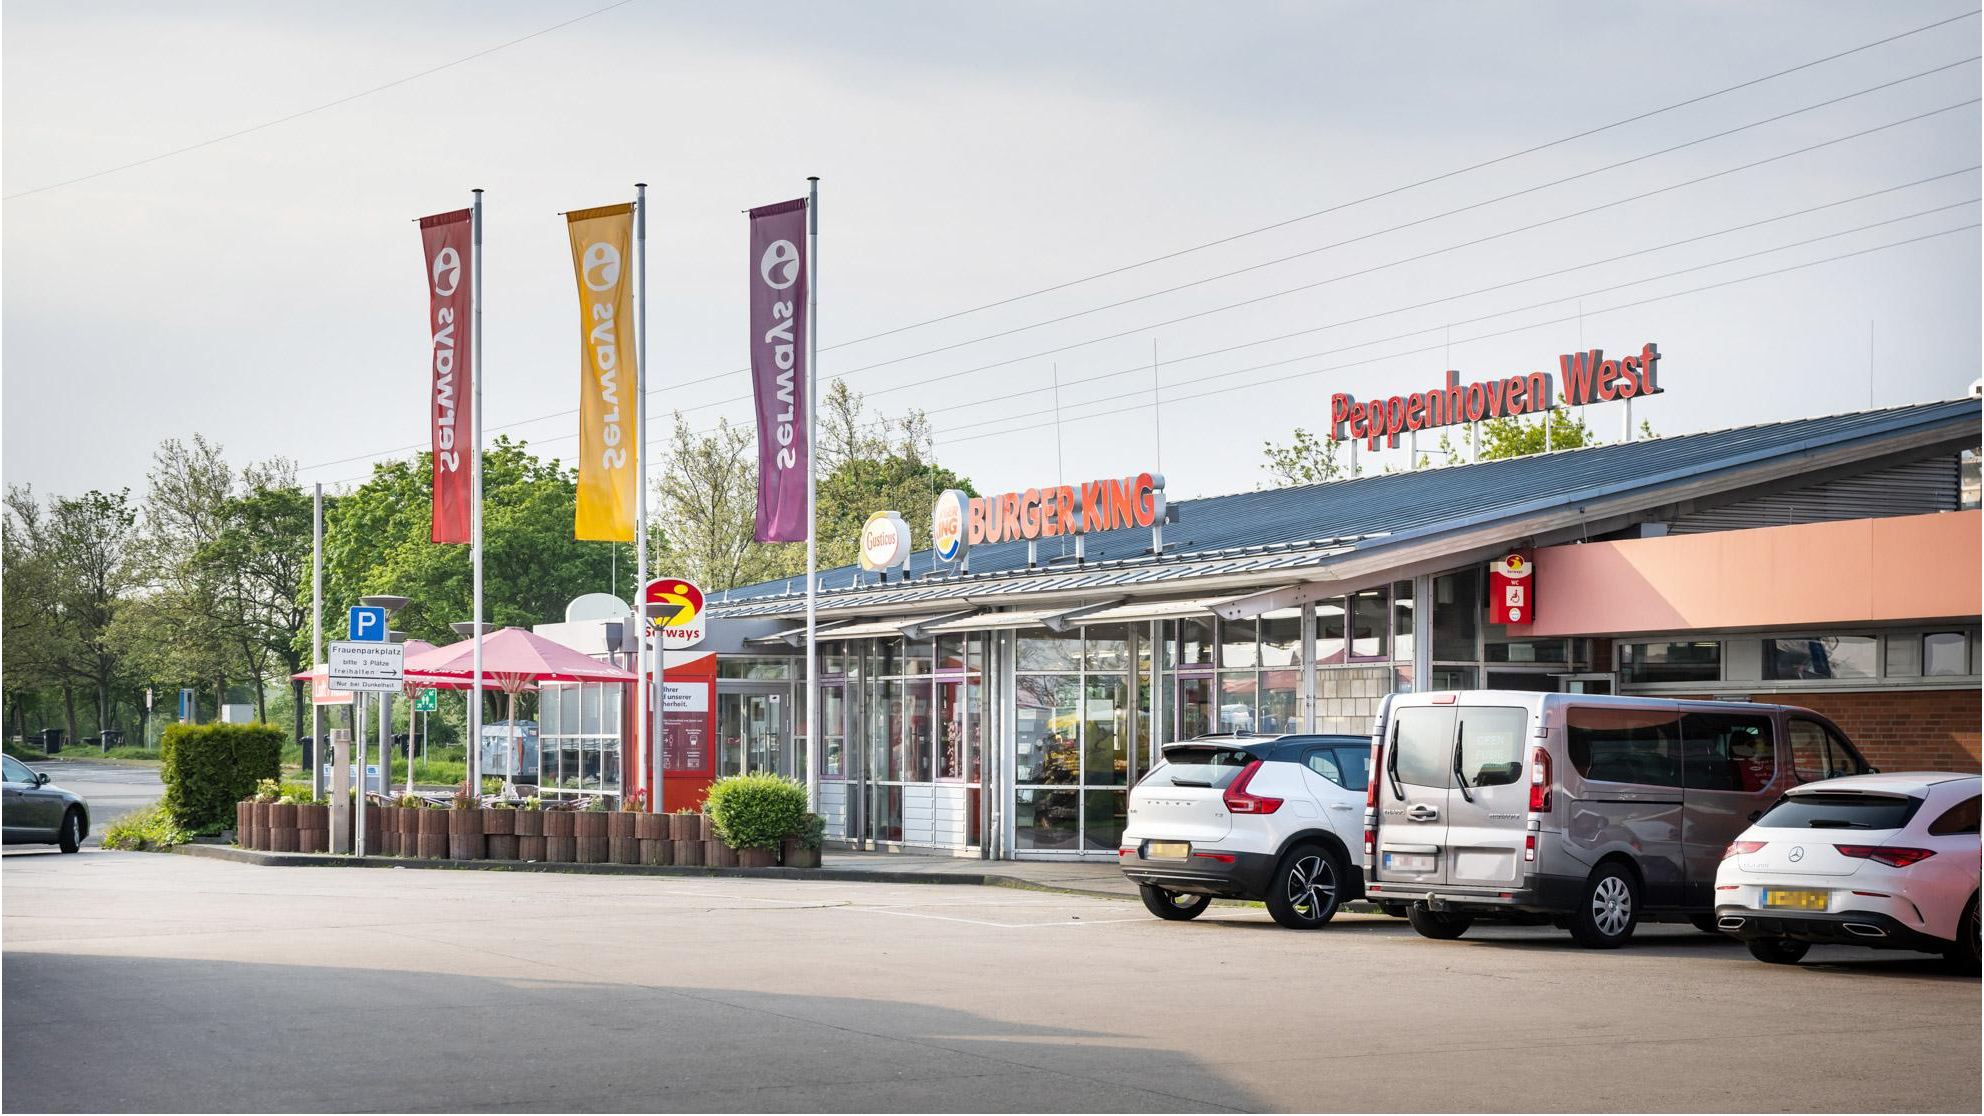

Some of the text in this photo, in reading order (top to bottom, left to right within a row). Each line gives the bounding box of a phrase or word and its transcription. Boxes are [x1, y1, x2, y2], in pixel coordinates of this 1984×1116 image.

[1331, 343, 1659, 451] Peppenhoven West
[968, 472, 1155, 545] BURGER KING
[936, 518, 958, 539] ING
[358, 611, 376, 636] P
[332, 646, 401, 656] Frauenparkplatz
